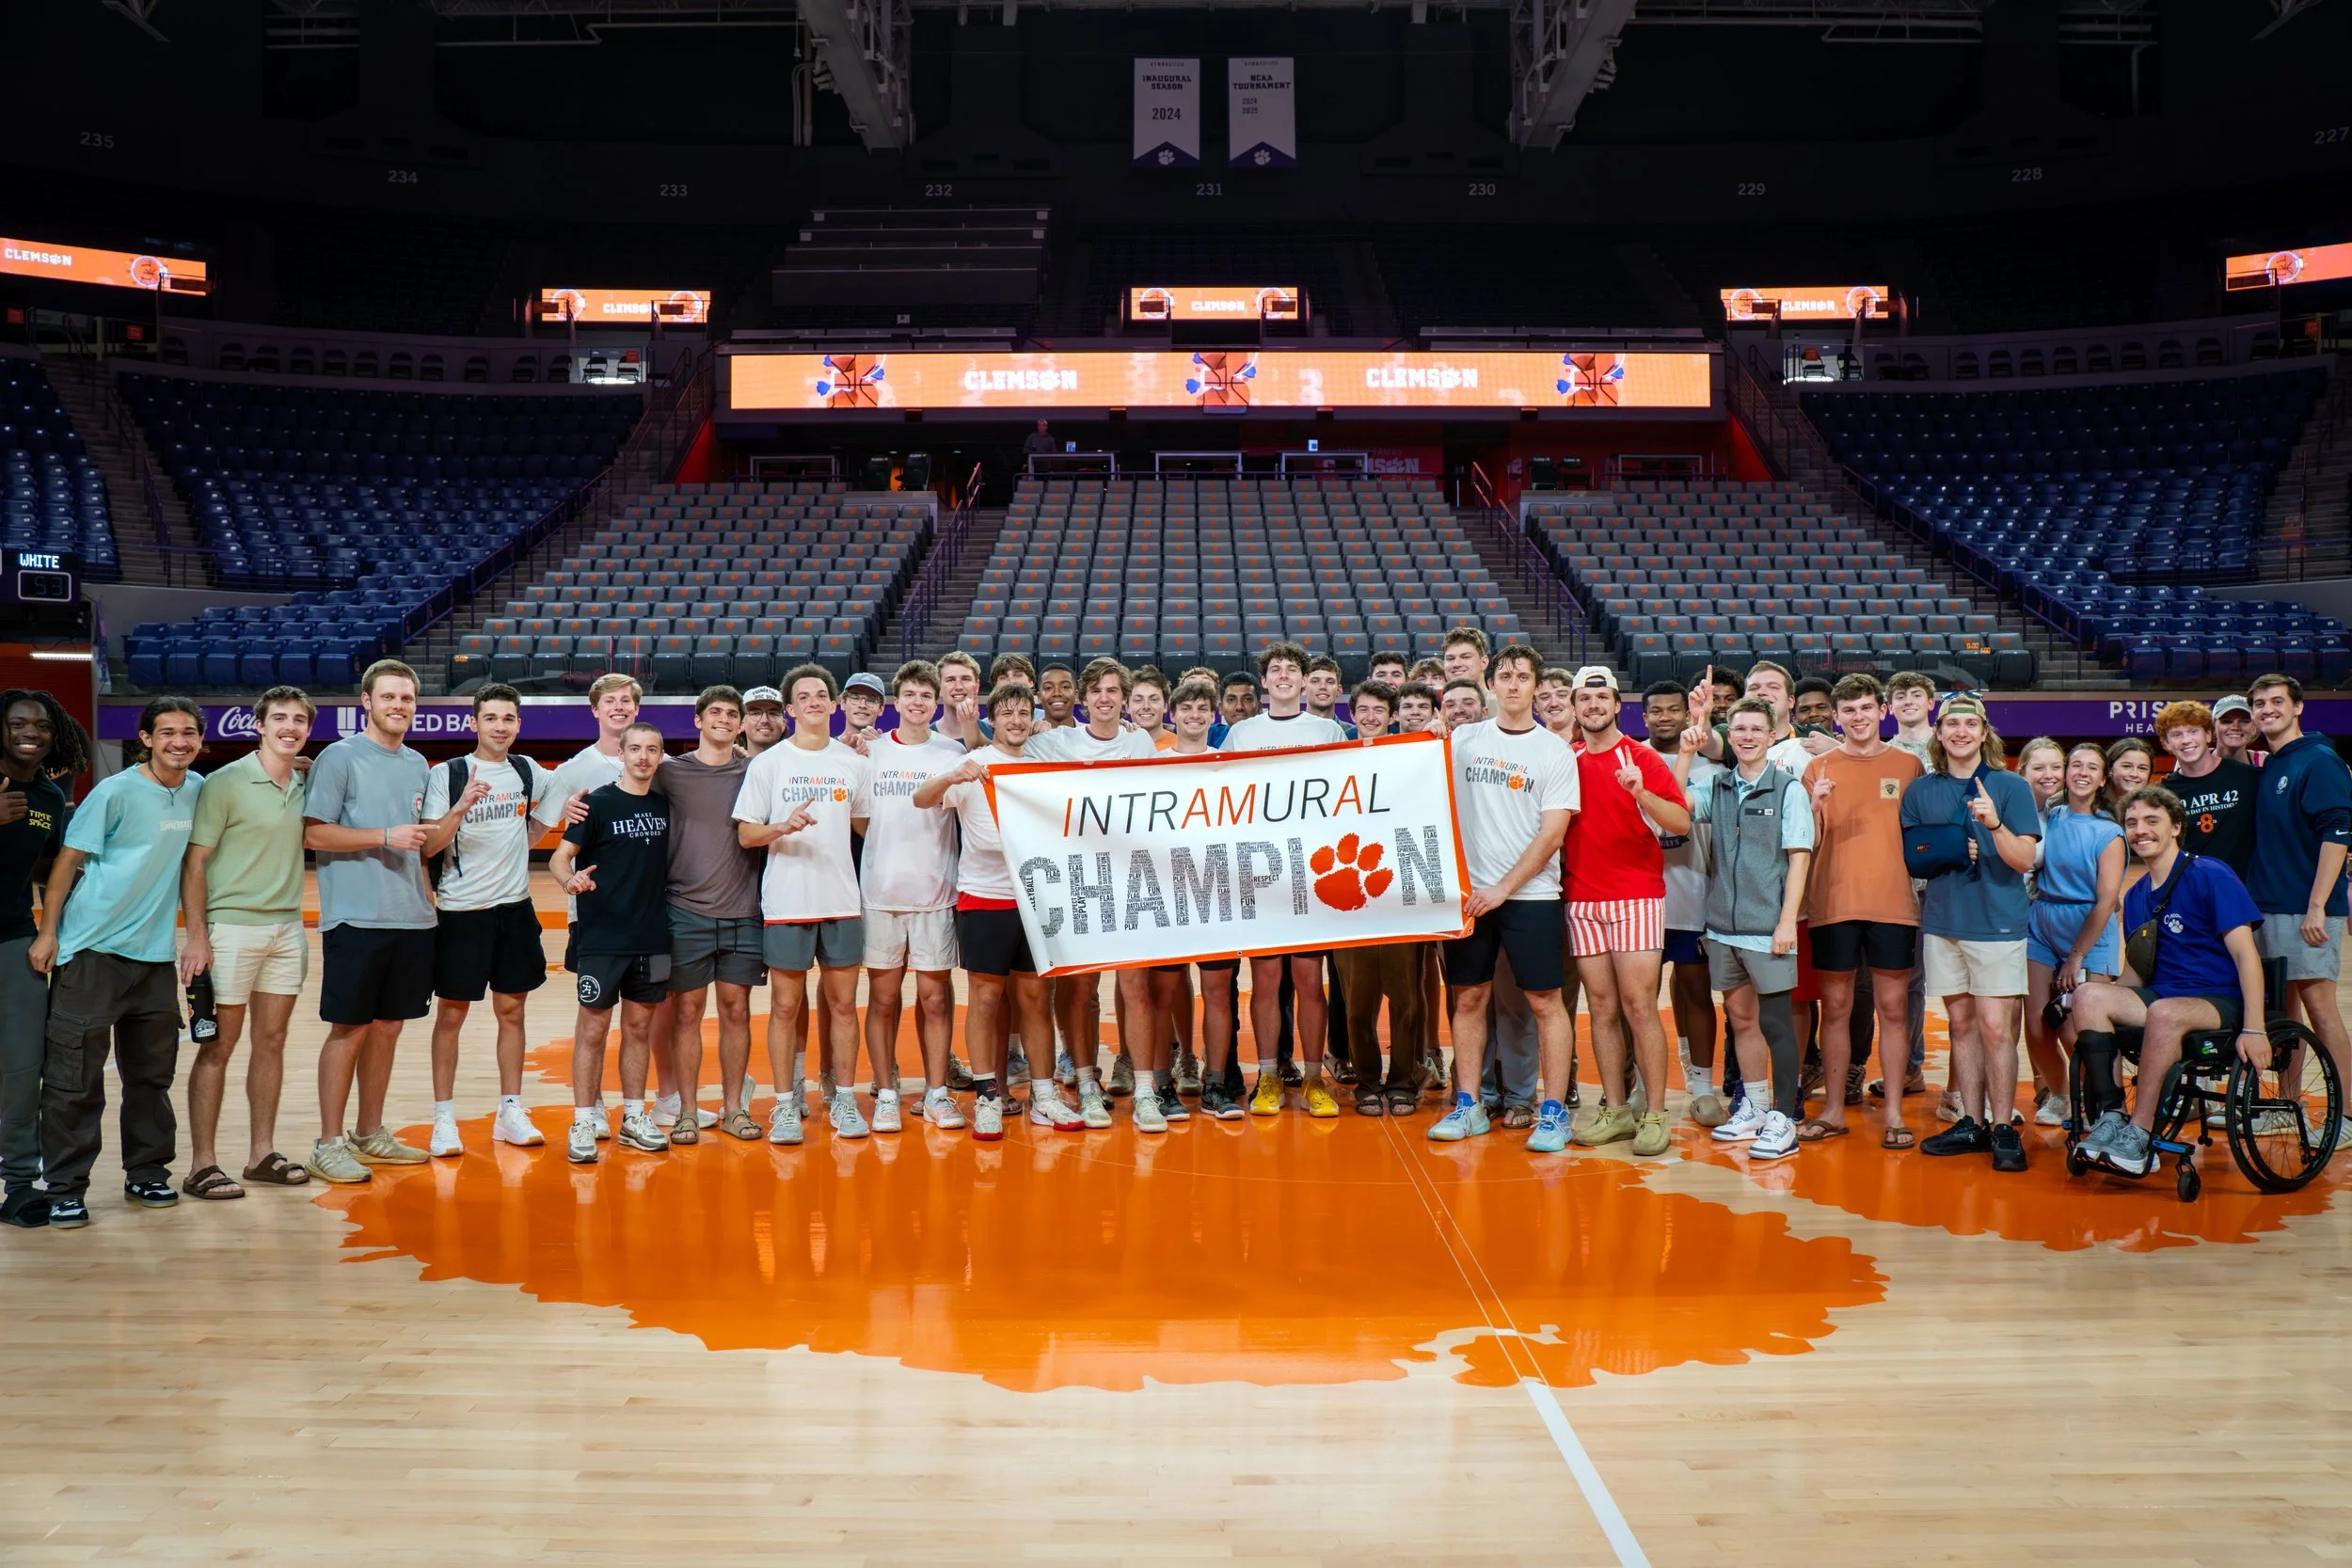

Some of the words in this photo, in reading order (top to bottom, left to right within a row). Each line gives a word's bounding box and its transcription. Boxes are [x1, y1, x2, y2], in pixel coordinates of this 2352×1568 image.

[1152, 107, 1182, 120] 2024
[80, 131, 114, 150] 235
[2313, 126, 2350, 145] 227
[388, 169, 418, 184] 234
[2011, 167, 2043, 182] 228
[660, 184, 688, 198] 233
[925, 183, 953, 198] 232
[1196, 183, 1223, 197] 231
[1468, 183, 1497, 197] 230
[1738, 182, 1767, 197] 229
[964, 369, 1077, 390] CLEMSON
[1366, 367, 1478, 389] CLEMSON
[19, 553, 60, 569] WHITE
[2109, 702, 2172, 720] PRIS
[1472, 757, 1529, 774] INTRAMURAL
[788, 777, 847, 786] INTRAMURAL
[879, 770, 936, 780] INTRAMURA
[1466, 767, 1535, 793] CHAMPION
[782, 787, 853, 803] CHAMPION
[2190, 792, 2220, 809] APR
[2222, 789, 2239, 802] 42
[1062, 772, 1391, 837] INTRAMURAL
[2211, 802, 2235, 812] HISTORY
[29, 809, 53, 821] TIME
[28, 818, 52, 830] SPACE
[612, 817, 667, 835] HEAVEN
[2200, 813, 2215, 833] 8
[1018, 825, 1446, 939] CHAMPION
[1148, 886, 1161, 895] FUN
[1078, 895, 1087, 914] PLAY
[1240, 897, 1256, 906] FUN
